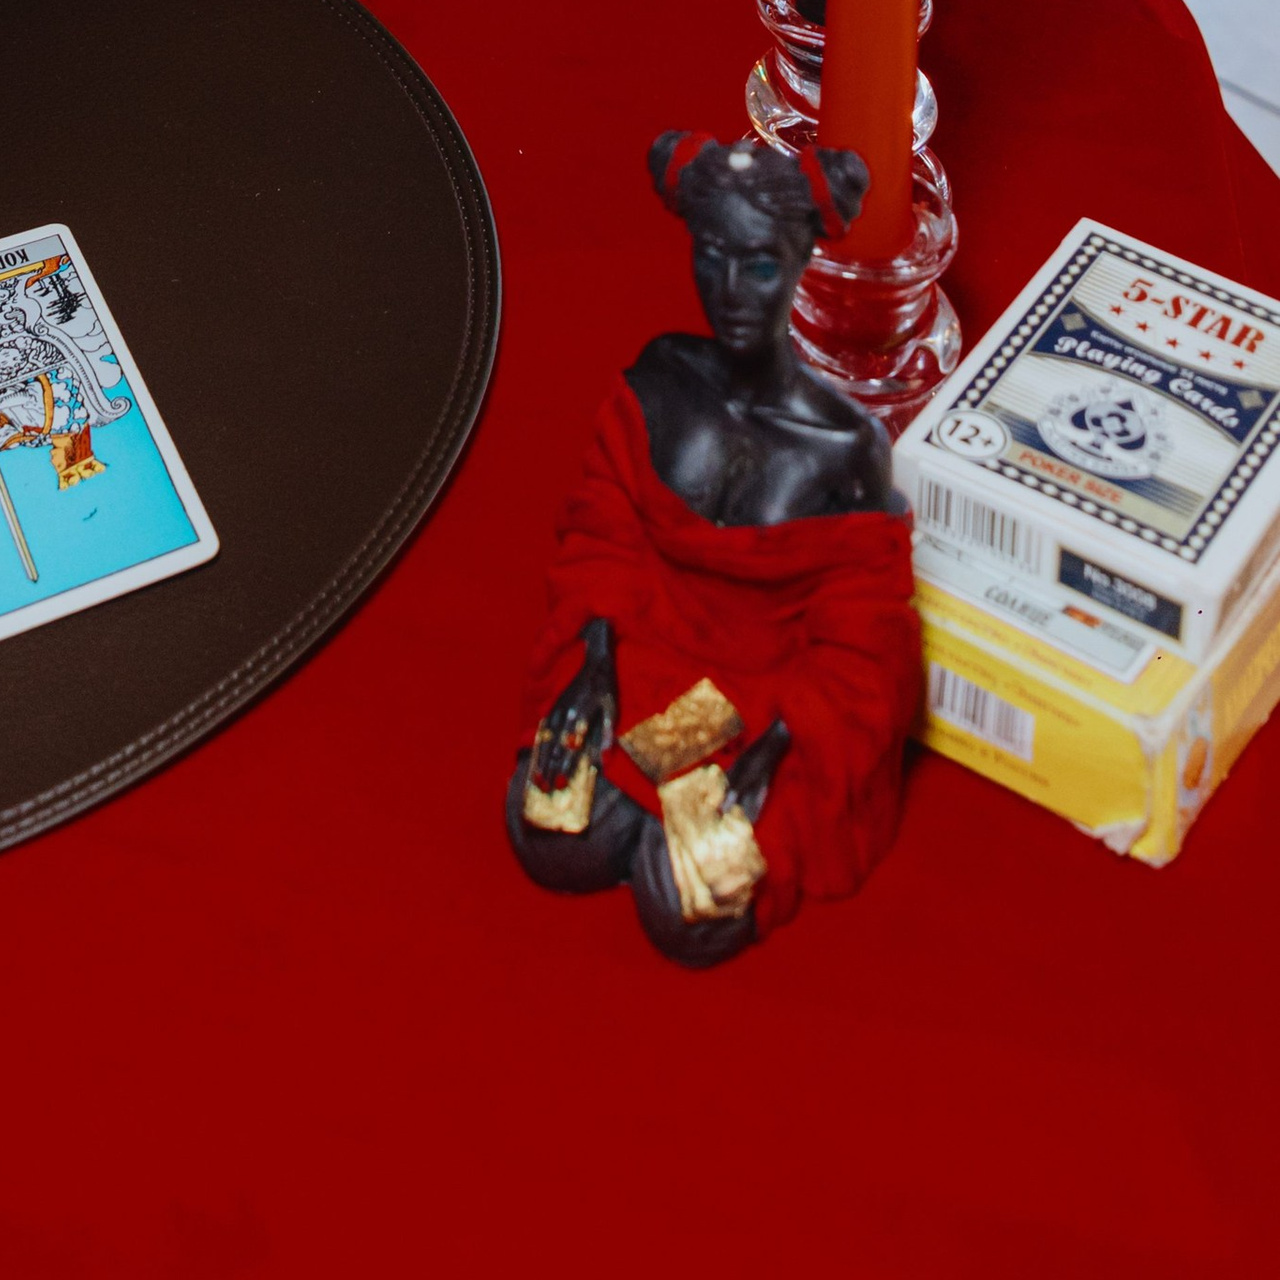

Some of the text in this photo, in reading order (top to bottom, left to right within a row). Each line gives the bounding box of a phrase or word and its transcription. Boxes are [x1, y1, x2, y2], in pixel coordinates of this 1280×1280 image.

[1122, 277, 1265, 354] 5-STAR
[1054, 336, 1239, 428] Playing Cards
[948, 419, 994, 447] 12+
[1019, 451, 1082, 485] POKER
